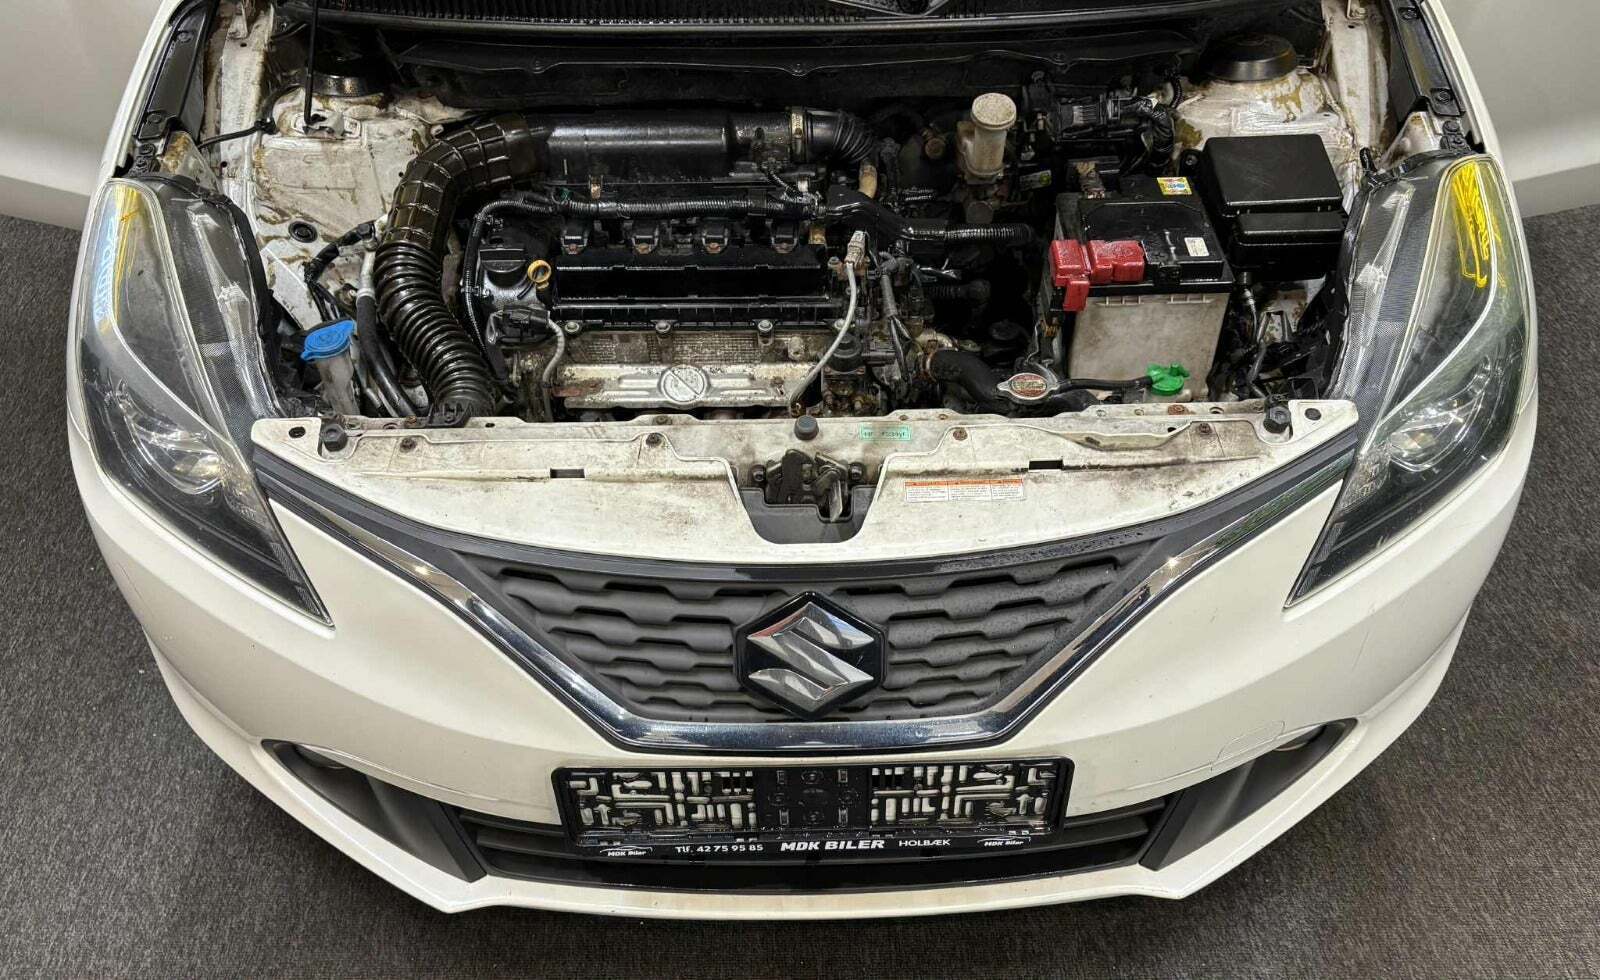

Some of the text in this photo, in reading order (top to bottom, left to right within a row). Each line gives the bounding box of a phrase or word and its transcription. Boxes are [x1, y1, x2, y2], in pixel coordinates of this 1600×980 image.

[780, 839, 885, 851] MDK BILER
[898, 839, 952, 847] HOLBÆK
